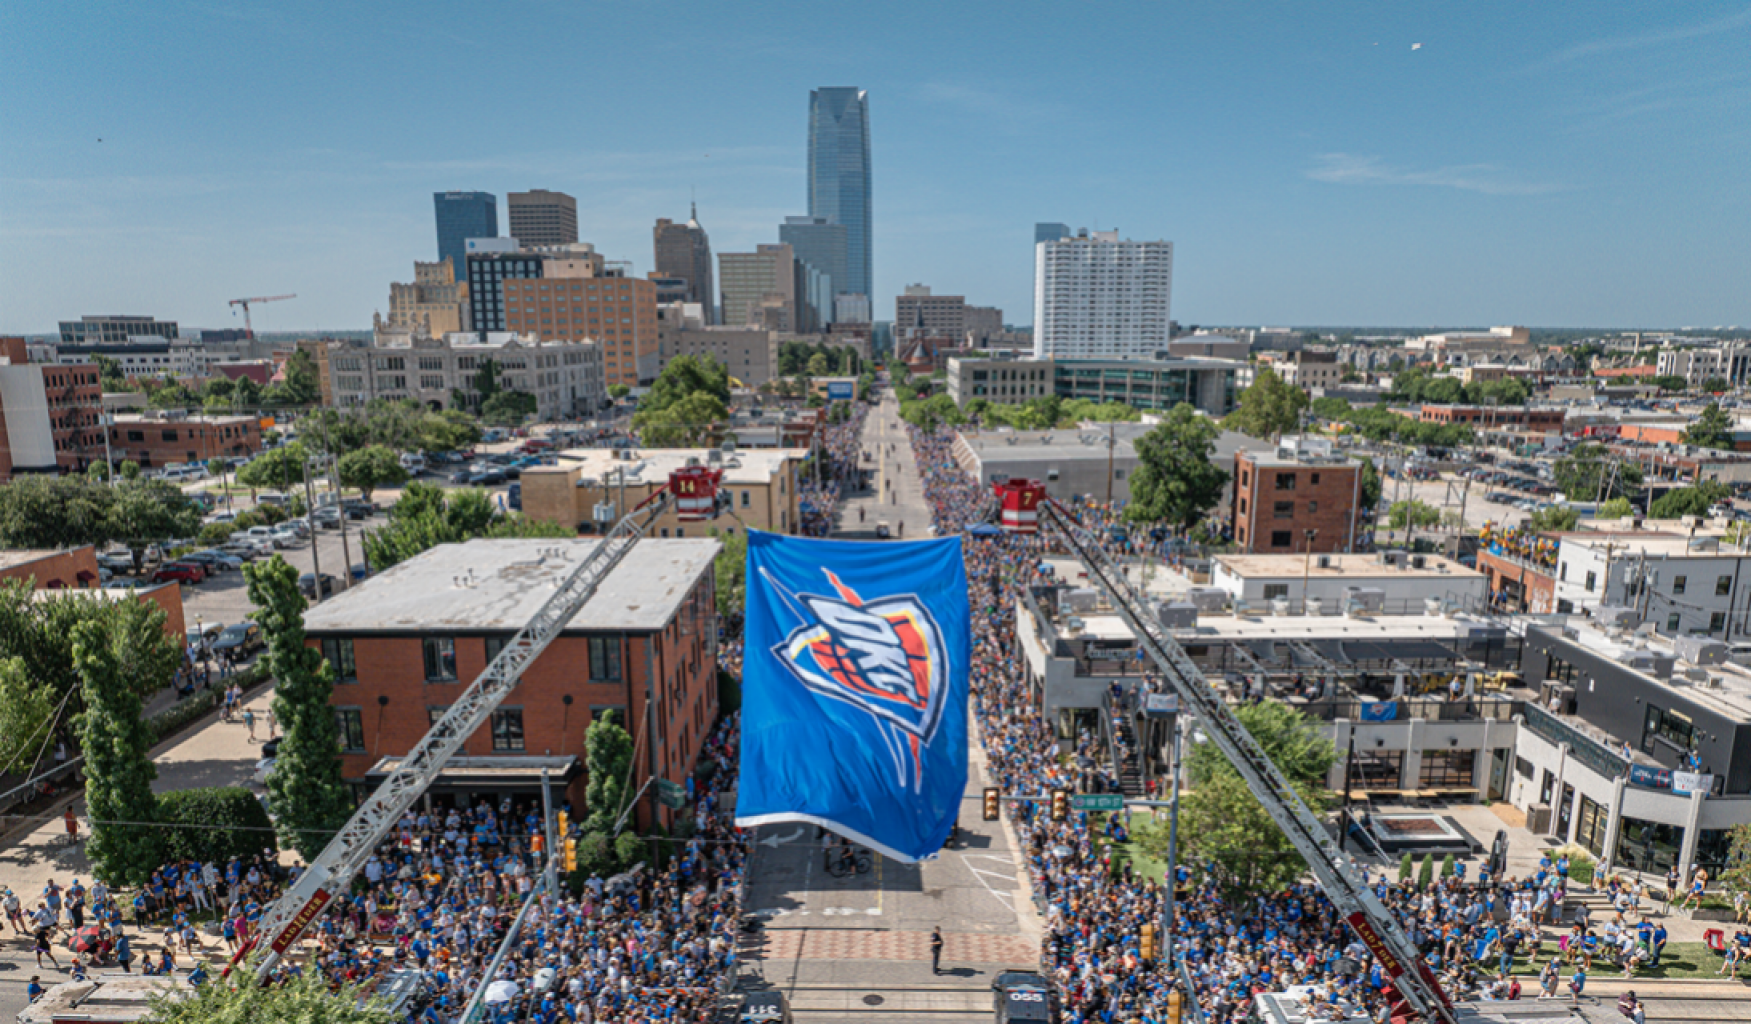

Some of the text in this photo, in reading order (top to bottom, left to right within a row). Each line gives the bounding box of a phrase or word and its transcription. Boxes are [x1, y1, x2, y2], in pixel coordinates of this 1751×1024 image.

[679, 479, 695, 493] 14
[1023, 492, 1034, 506] 7
[805, 598, 922, 705] OKC
